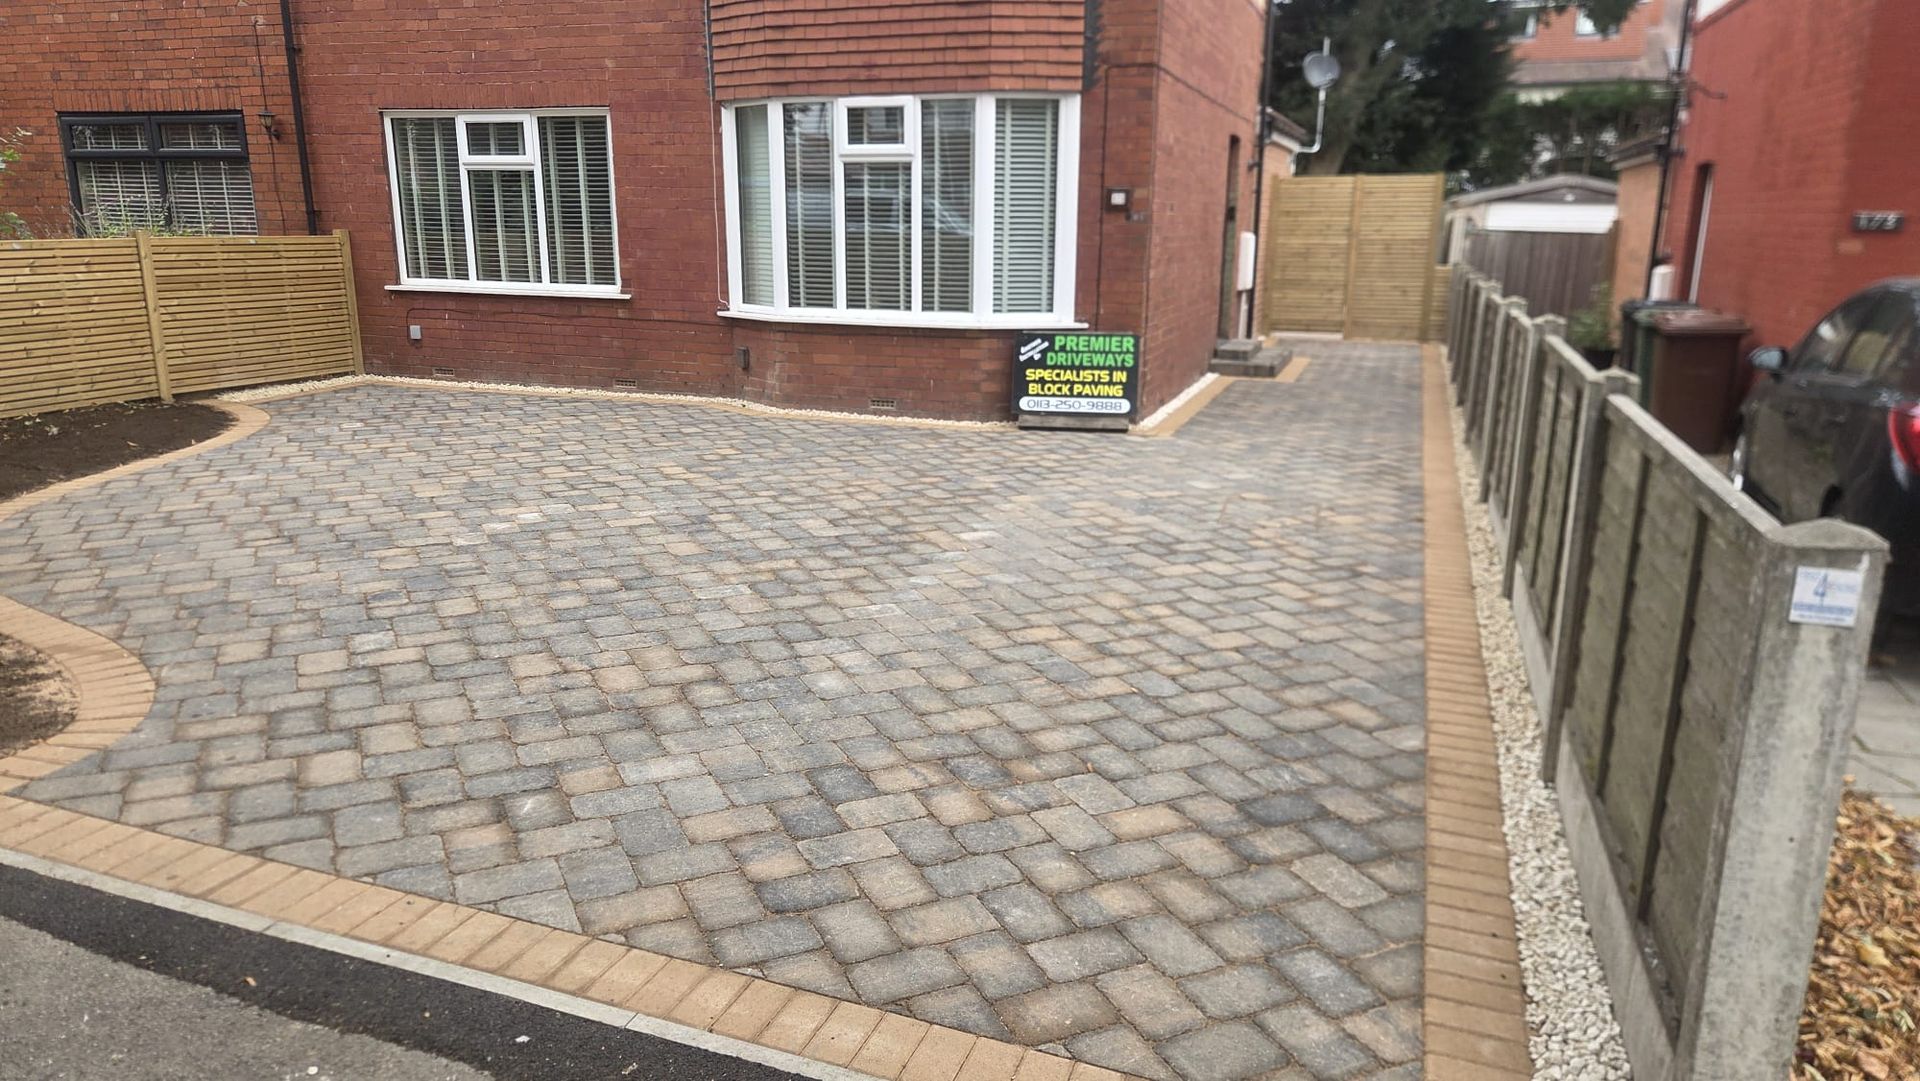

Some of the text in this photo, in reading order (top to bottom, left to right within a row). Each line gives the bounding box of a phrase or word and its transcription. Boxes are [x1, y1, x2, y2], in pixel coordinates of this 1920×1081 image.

[1054, 335, 1135, 352] PREMIER
[1046, 352, 1134, 367] DRIVEWAYS
[1025, 368, 1127, 383] SPECIALISTS IN
[1028, 383, 1123, 397] BLOCK PAVING
[1026, 399, 1122, 410] 0113-250-9888
